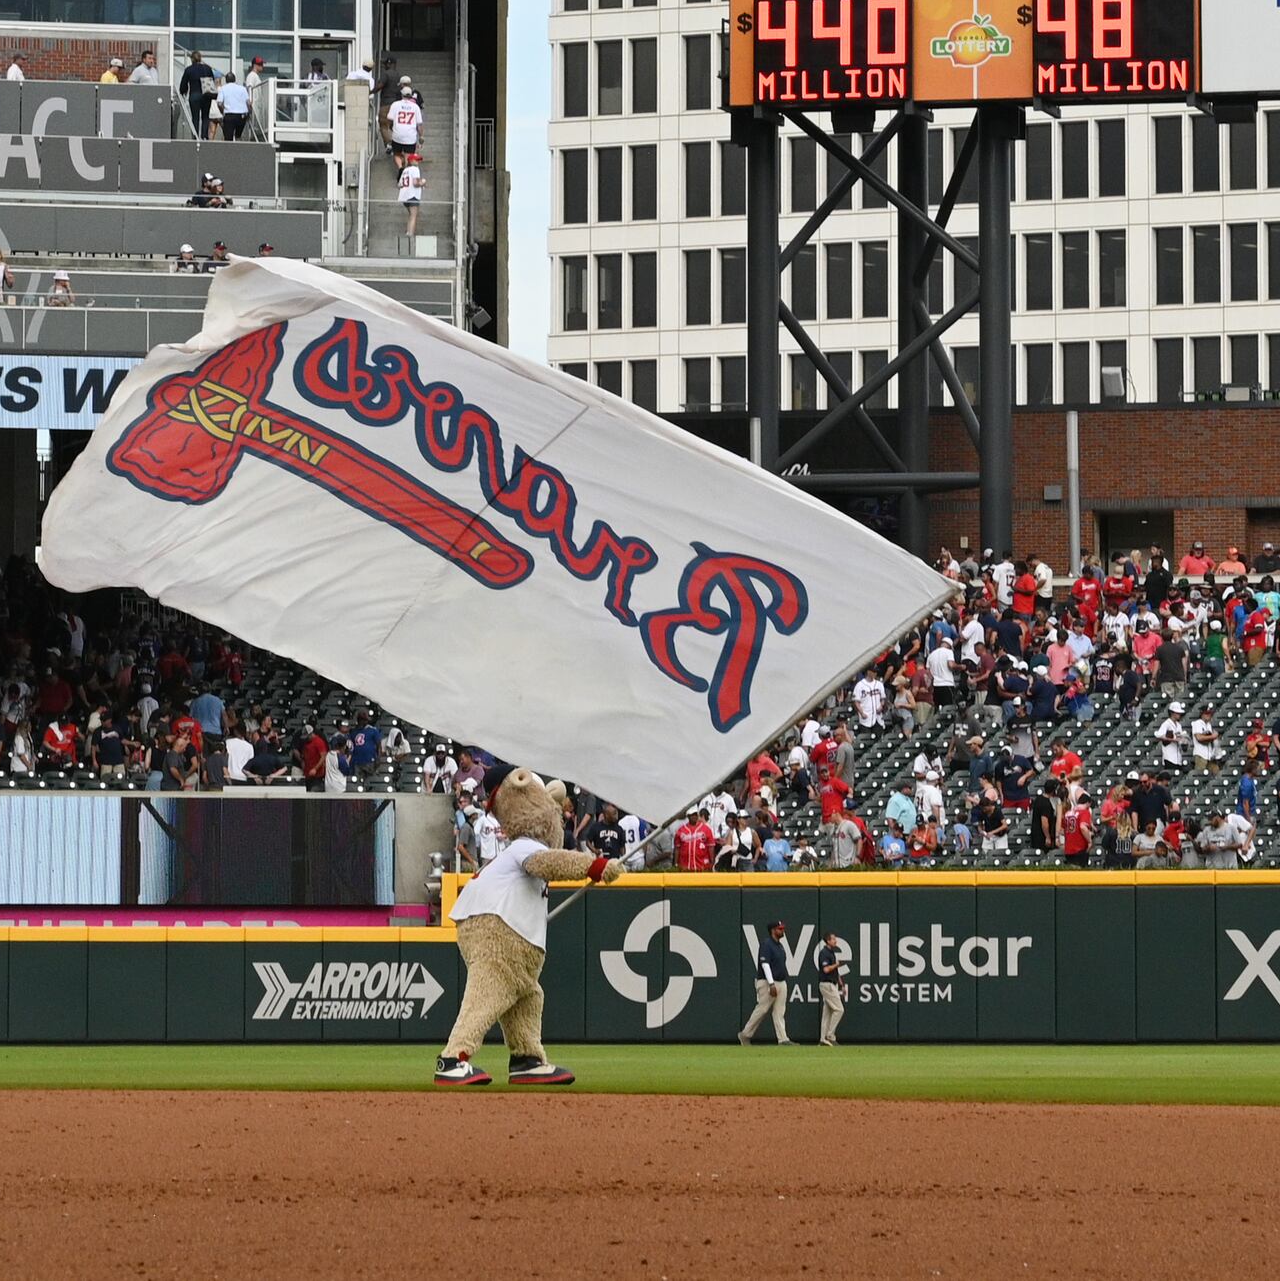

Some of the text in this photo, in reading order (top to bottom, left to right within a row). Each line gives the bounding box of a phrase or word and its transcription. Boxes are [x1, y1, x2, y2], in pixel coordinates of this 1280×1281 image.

[935, 39, 1007, 54] LOTTERY
[757, 69, 907, 101] MILLION
[1037, 59, 1188, 95] MILLION
[397, 111, 415, 125] 27
[1115, 838, 1132, 854] 10
[742, 922, 1033, 977] Wellstar
[298, 961, 420, 999] ARROW
[859, 983, 953, 1003] SYSTEM
[291, 1000, 415, 1020] EXTERMINATORS
